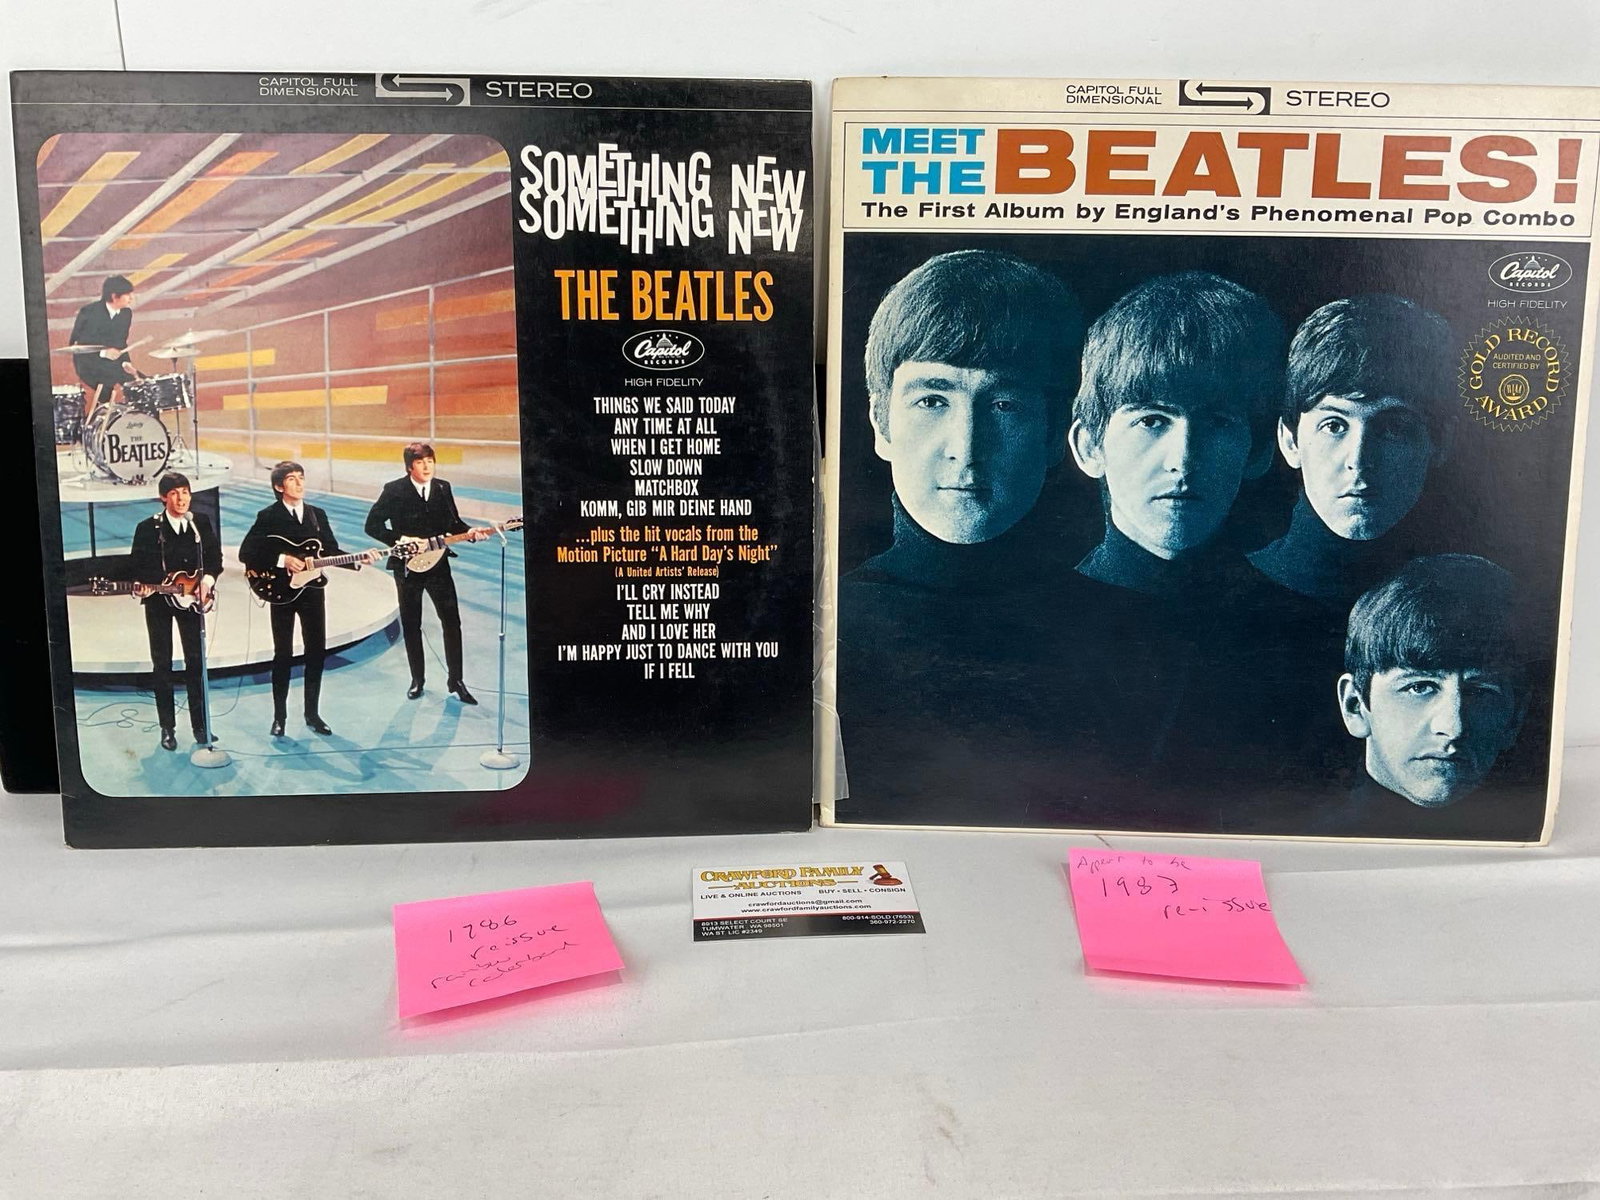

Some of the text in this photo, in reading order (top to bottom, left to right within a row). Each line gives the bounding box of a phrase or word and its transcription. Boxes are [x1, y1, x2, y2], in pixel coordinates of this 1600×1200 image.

[259, 77, 358, 88] CAPITOL FULL
[486, 81, 593, 99] STEREO
[1066, 84, 1162, 95] CAPITOL FULL
[259, 87, 359, 97] DIMENSIONAL
[1066, 95, 1162, 105] DIMENSIONAL
[1286, 90, 1391, 108] STEREO
[862, 128, 986, 155] MEET
[862, 129, 1583, 204] THE BEATLES!
[520, 143, 806, 214] SOMETHING NEW
[518, 187, 803, 255] SOMETHING NEW
[862, 202, 1575, 227] The First Album by England's Phenomenal Pop Combo
[1500, 261, 1560, 281] Capitol
[554, 269, 774, 321] THE BEATLES
[1487, 300, 1568, 309] HIGH FIDELITY
[634, 340, 692, 359] Capitol
[1493, 353, 1524, 361] AUDITED
[1469, 334, 1500, 390] GOLD
[1507, 328, 1561, 392] RECORD
[625, 378, 704, 387] HIGH FIDELITY
[594, 396, 736, 414] THINGS WE SAID TODAY
[1474, 396, 1548, 421] AWARD
[614, 417, 717, 435] ANY TIME AT ALL
[108, 434, 165, 468] BEATLES
[610, 438, 721, 455] WHEN I GET HOME
[629, 459, 703, 476] SLOW DOWN
[634, 479, 699, 496] MATCHBOX
[580, 499, 752, 520] KOMM, GIB MIR DEINE HAND
[620, 526, 640, 542] the
[644, 525, 661, 541] hit
[665, 525, 702, 542] vocals
[706, 525, 734, 541] from
[738, 525, 759, 541] the
[557, 546, 598, 563] Motion
[603, 546, 647, 562] Picture
[670, 545, 698, 562] Hard
[615, 567, 624, 578] (A
[626, 566, 652, 578] United
[687, 566, 720, 578] Release)
[642, 584, 666, 600] CRY
[670, 583, 720, 600] INSTEAD
[626, 603, 711, 621] TELL ME WHY
[621, 623, 717, 641] AND I LOVE HER
[582, 644, 621, 661] HAPPY
[625, 643, 653, 660] JUST
[657, 643, 673, 660] TO
[677, 642, 717, 659] DANCE
[721, 642, 751, 659] WITH
[755, 641, 779, 658] YOU
[644, 662, 696, 680] IF I FELL
[700, 866, 864, 882] CRAWFORD FAMILY
[734, 879, 837, 890] AUCTIONS
[741, 904, 872, 913] www.crawfordfamilyauctions.com
[748, 899, 862, 908] crawfordauctions@gmail.com
